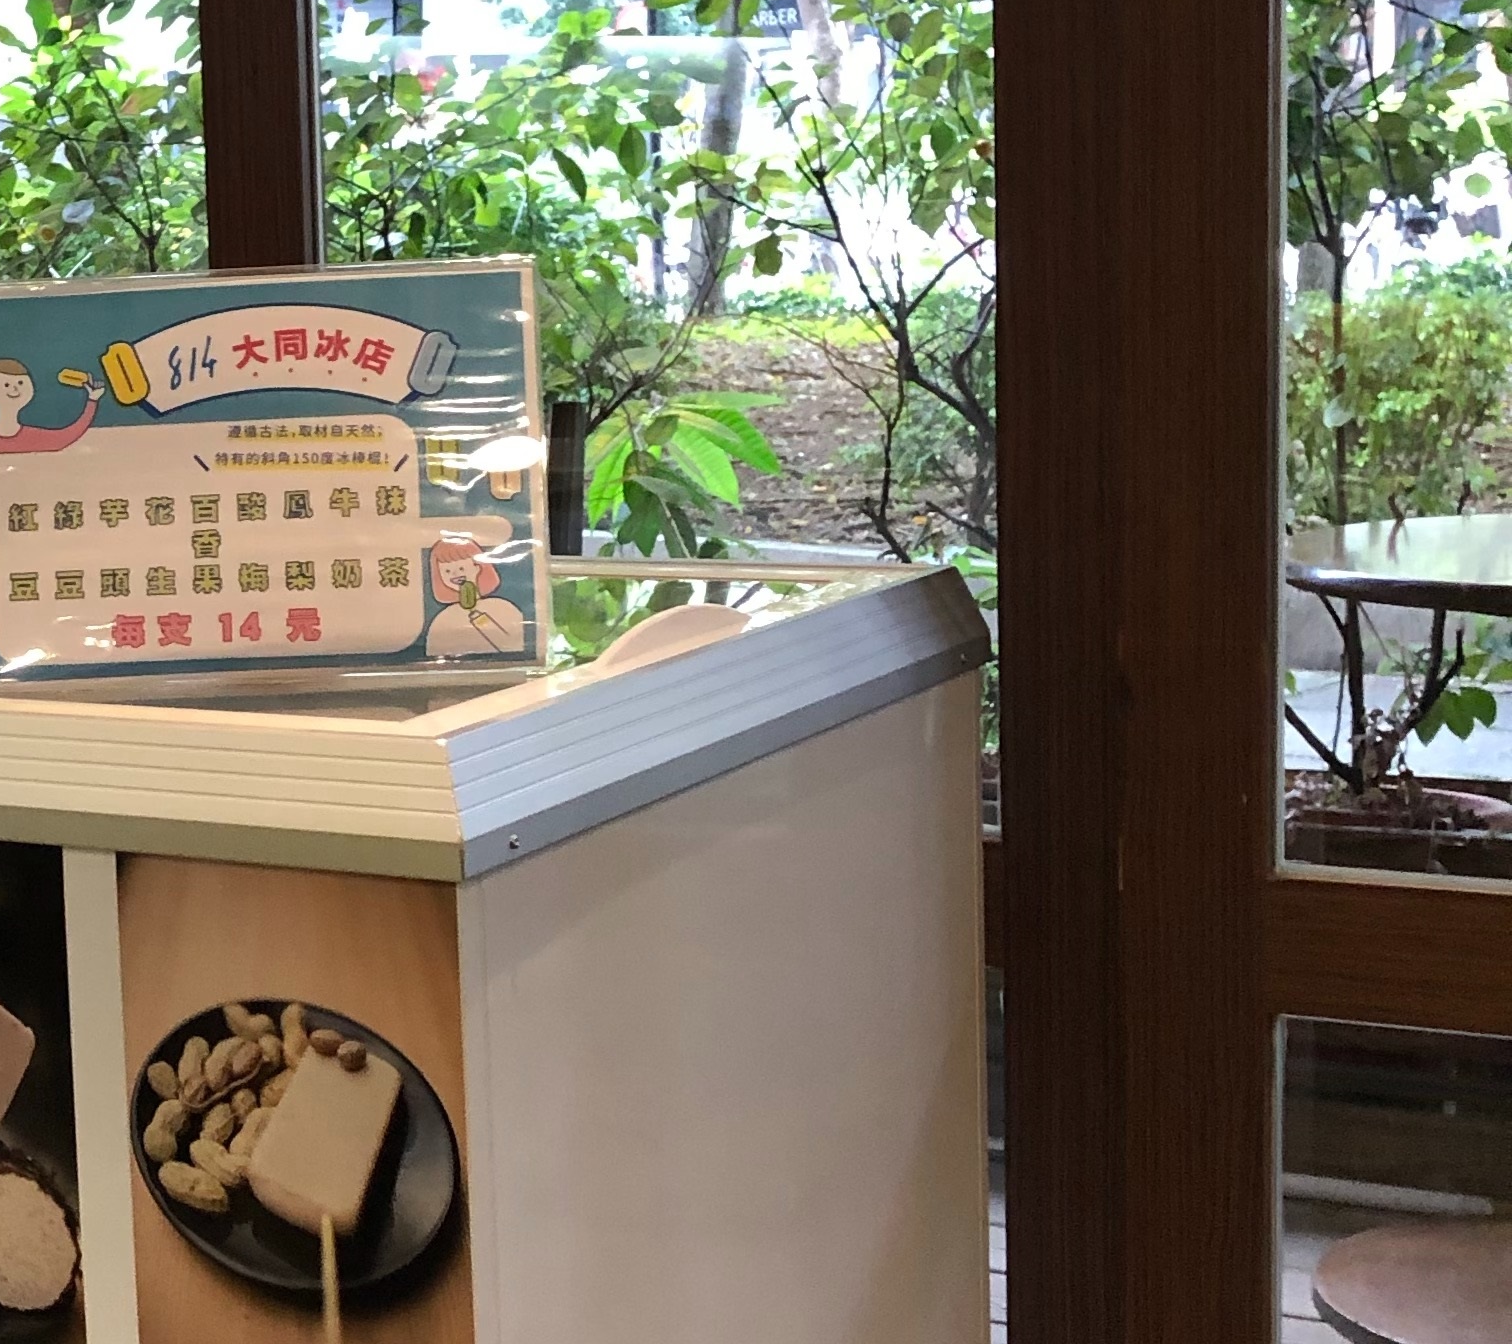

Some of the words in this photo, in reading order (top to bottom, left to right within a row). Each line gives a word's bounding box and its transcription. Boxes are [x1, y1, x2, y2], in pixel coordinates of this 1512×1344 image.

[167, 335, 218, 391] 814
[232, 328, 396, 376] 大同冰店
[218, 611, 262, 643] 14
[286, 607, 322, 642] 元
